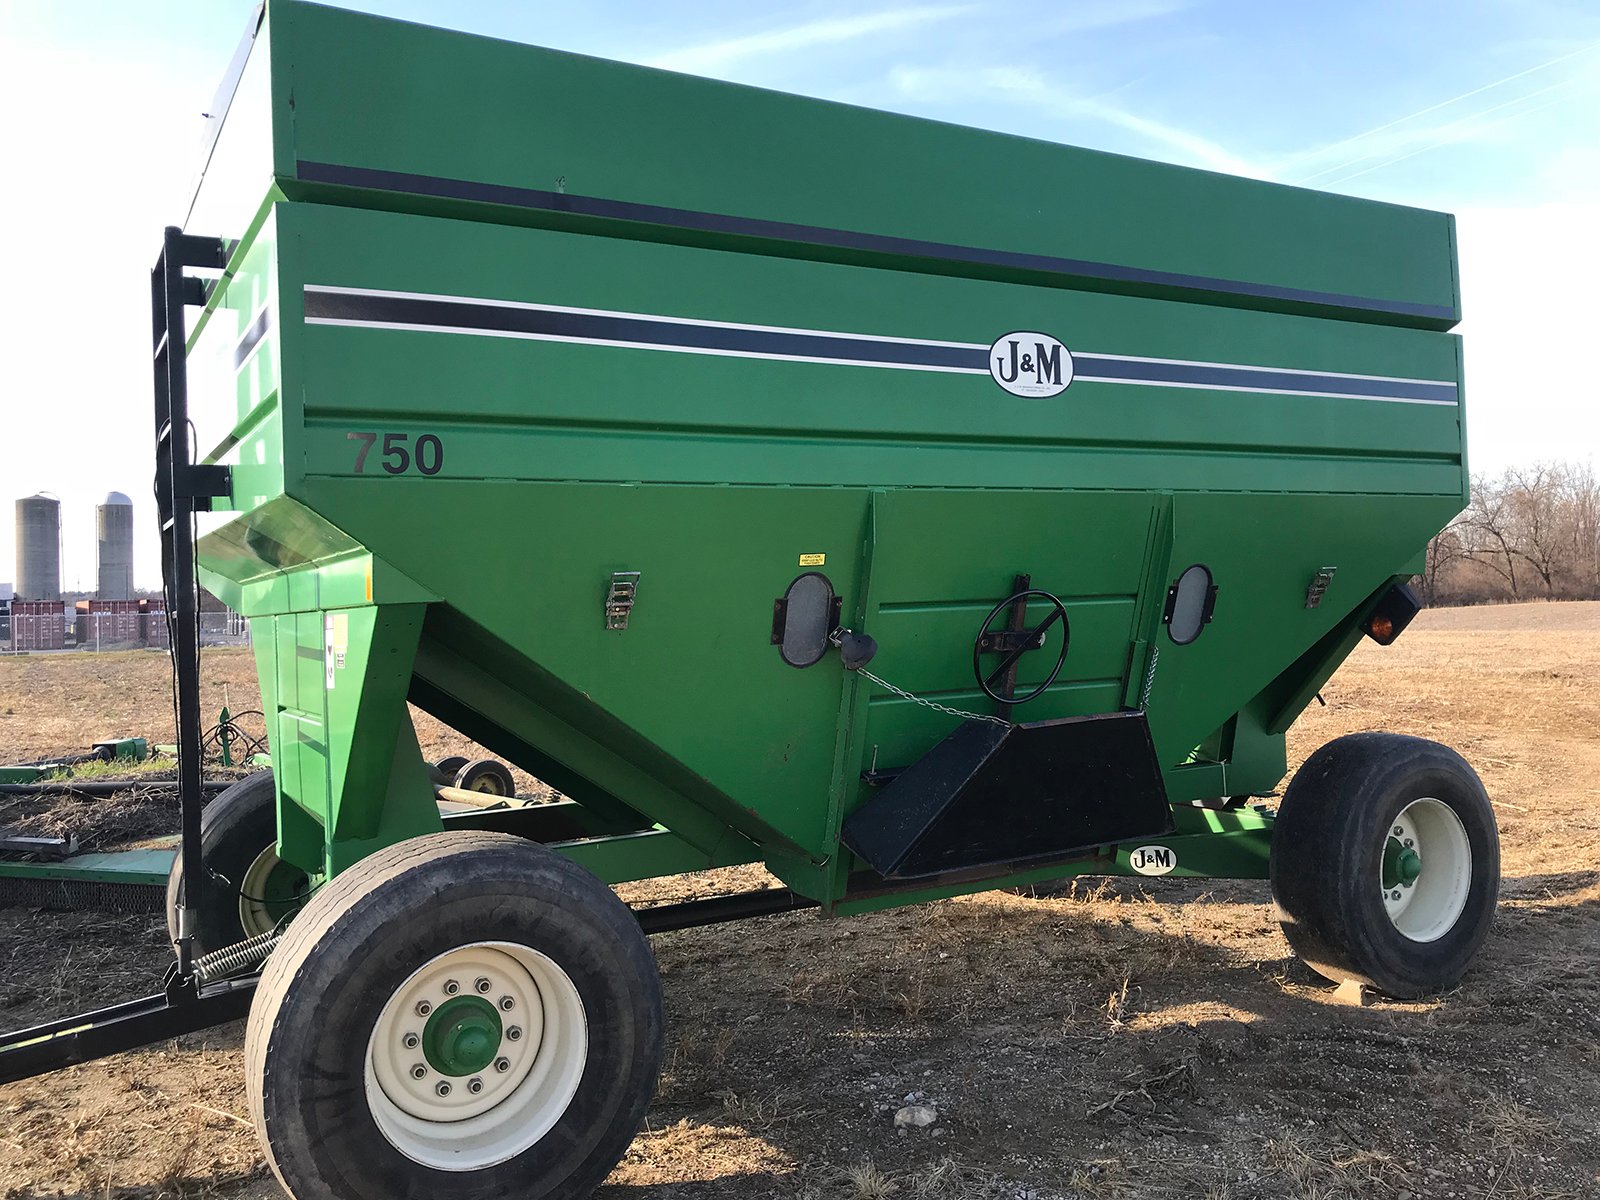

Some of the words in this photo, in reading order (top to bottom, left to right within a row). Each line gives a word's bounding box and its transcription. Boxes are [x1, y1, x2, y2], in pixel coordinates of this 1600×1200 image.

[996, 340, 1063, 386] J&M
[346, 431, 444, 476] 750
[1133, 849, 1172, 869] J&M
